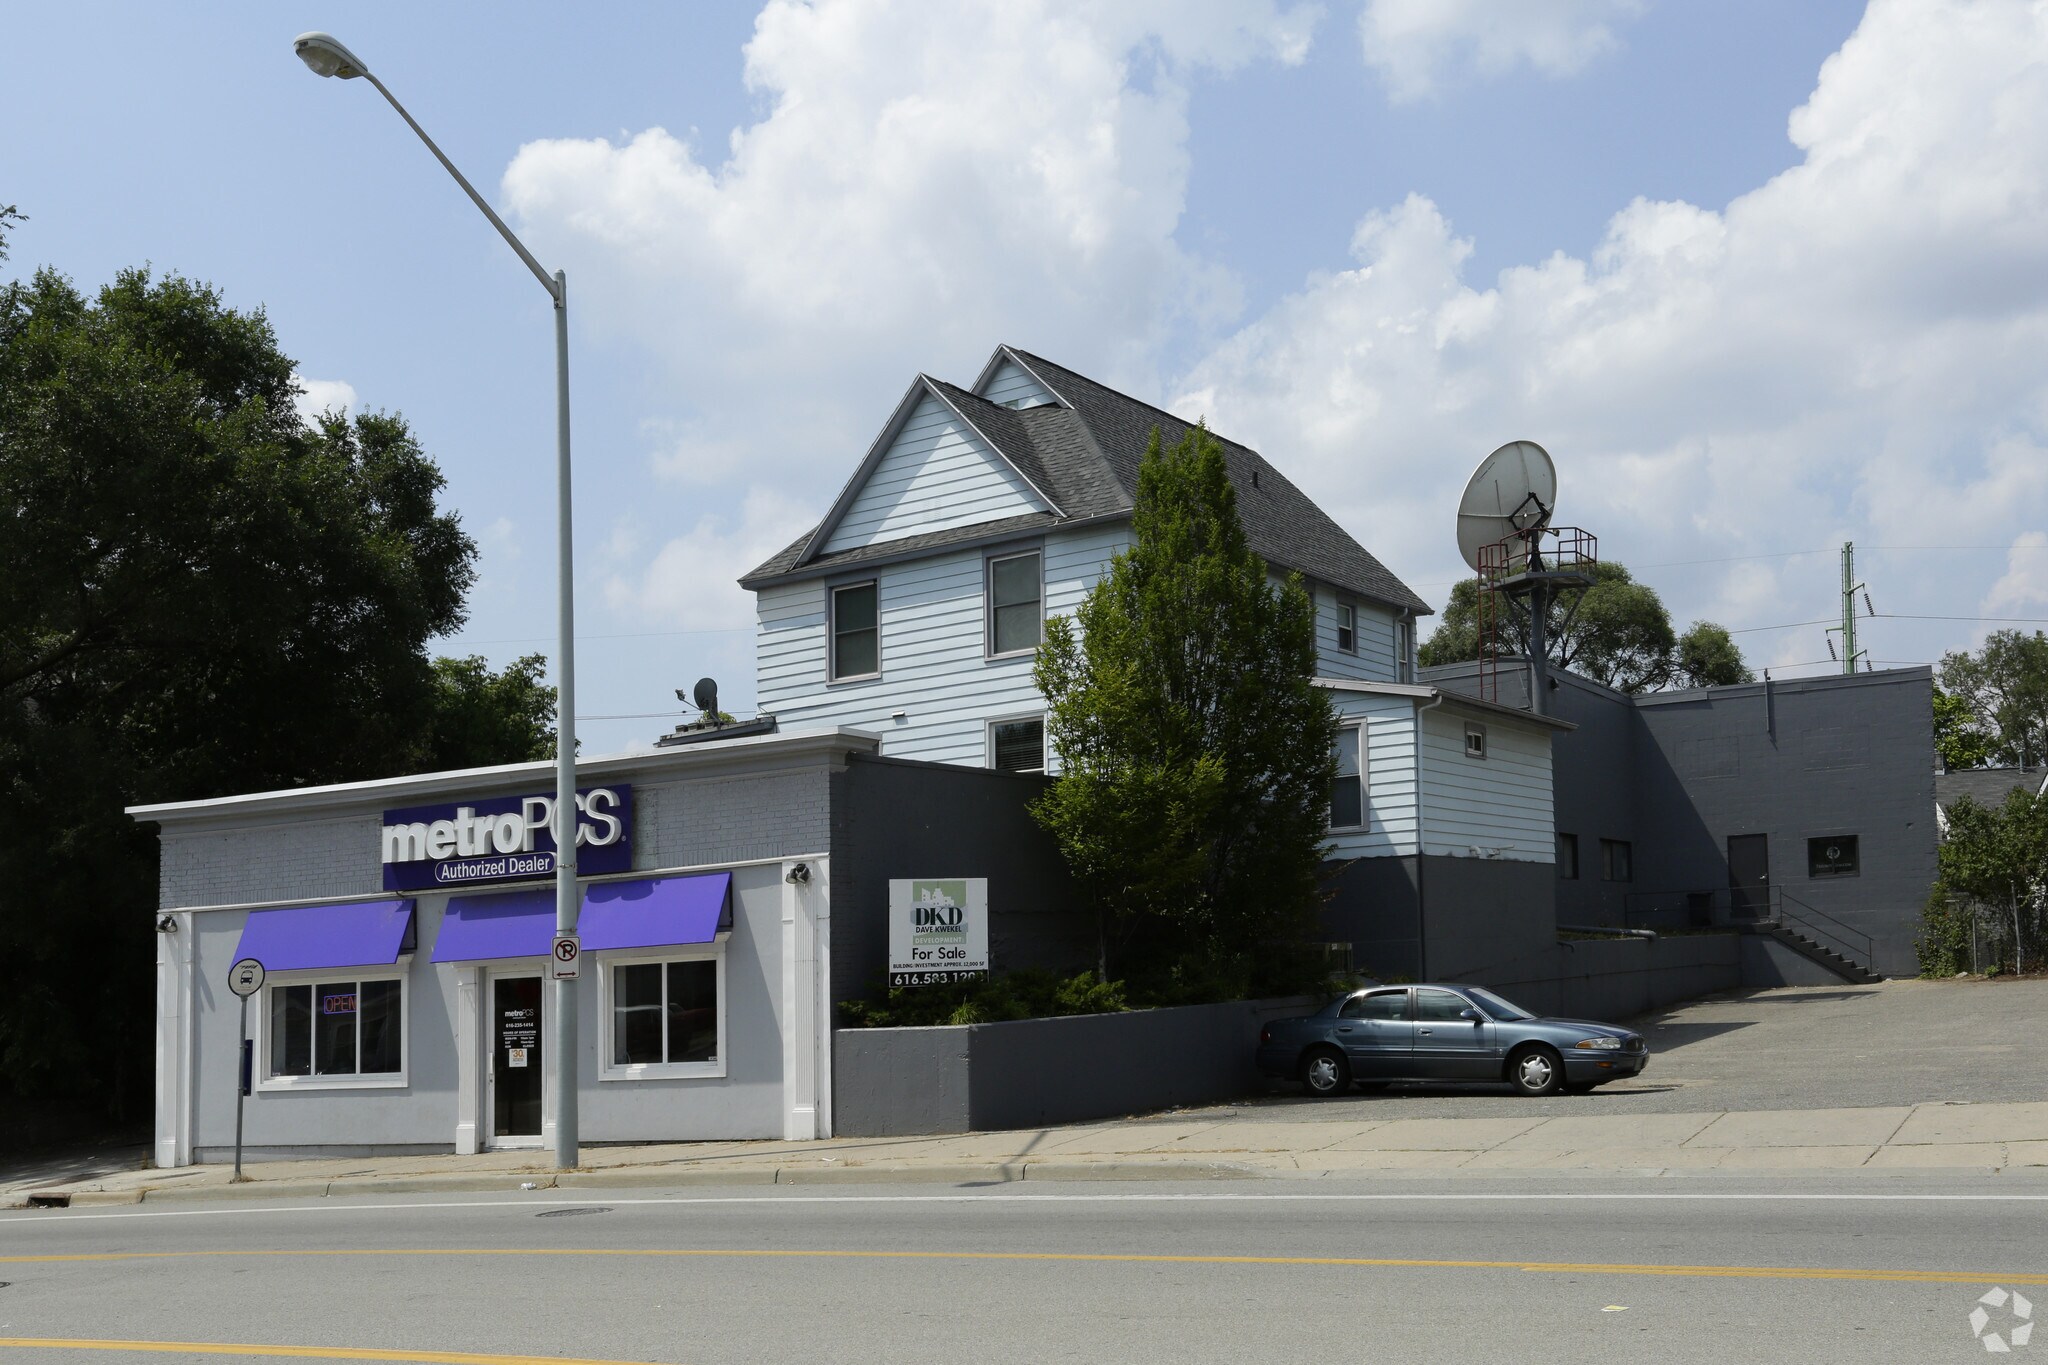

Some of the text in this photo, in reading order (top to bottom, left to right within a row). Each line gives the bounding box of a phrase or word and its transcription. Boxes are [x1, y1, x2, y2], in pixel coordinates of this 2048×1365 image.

[382, 788, 622, 864] metroPCS
[441, 856, 550, 880] Authorized Dealer
[916, 907, 962, 925] DKD
[912, 946, 966, 960] For Sale
[326, 996, 356, 1012] OPEN
[505, 1009, 534, 1017] metroPCS
